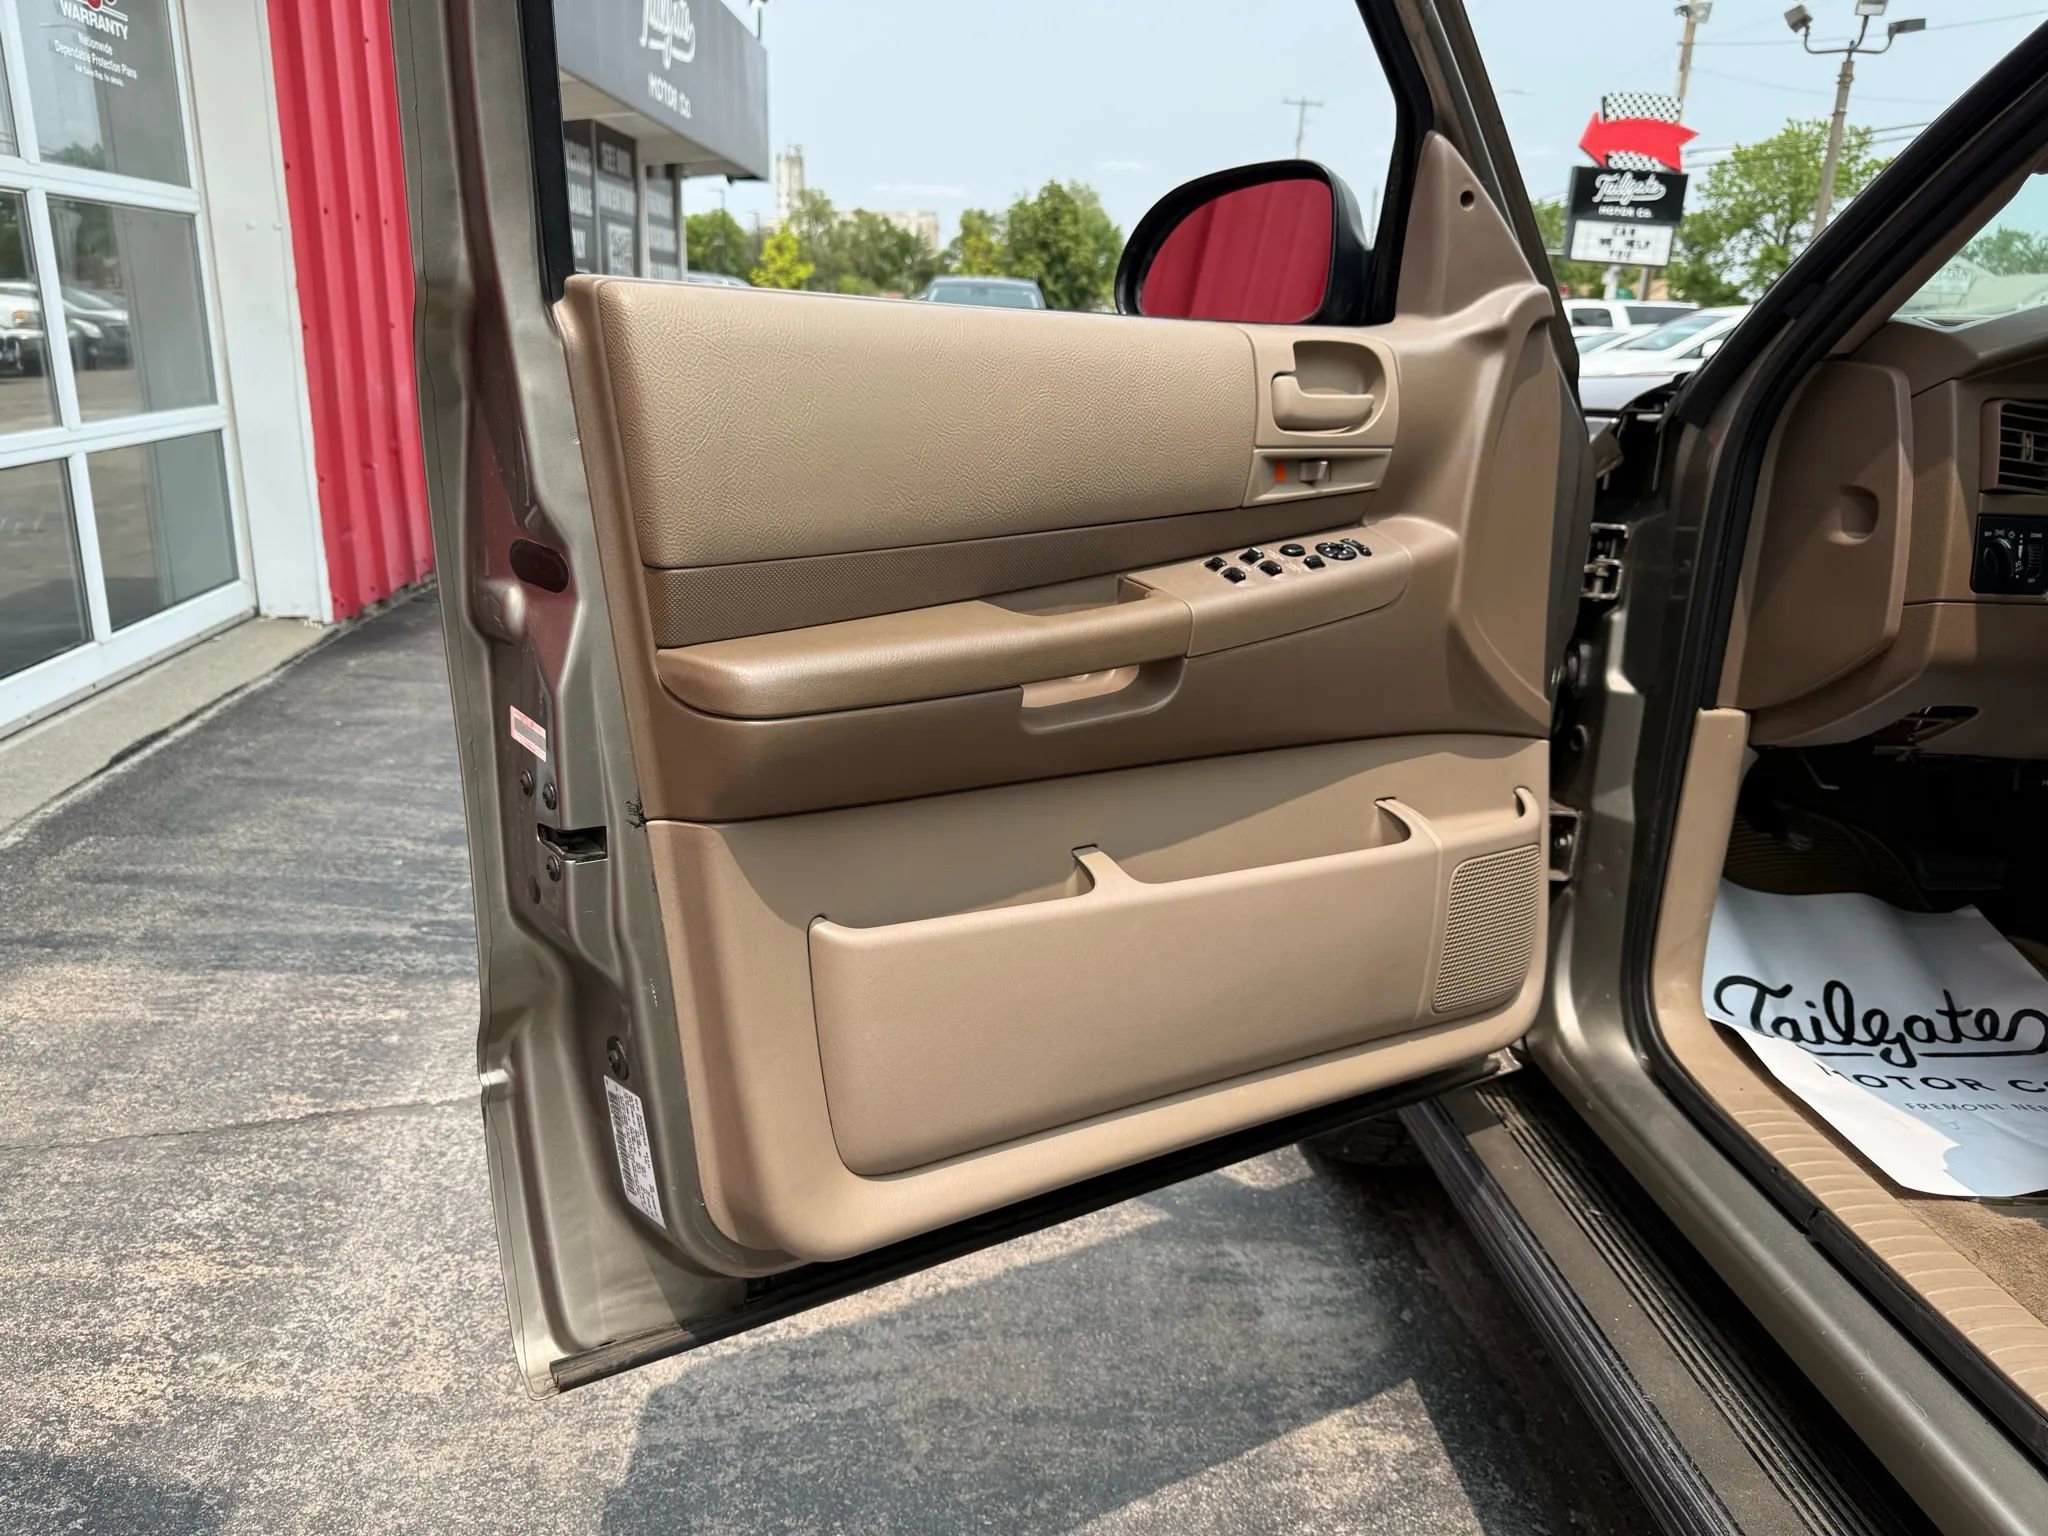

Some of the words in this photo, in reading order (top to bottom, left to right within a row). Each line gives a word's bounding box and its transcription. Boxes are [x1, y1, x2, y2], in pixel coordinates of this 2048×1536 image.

[60, 0, 128, 40] WARRANTY
[55, 39, 91, 64] Dependable
[91, 52, 121, 74] Protection
[78, 31, 113, 56] Nationwide
[647, 72, 678, 113] MOTOR
[1713, 975, 2048, 1068] Tailgate
[2007, 1079, 2048, 1093] C
[1904, 1102, 2005, 1112] FREMONT
